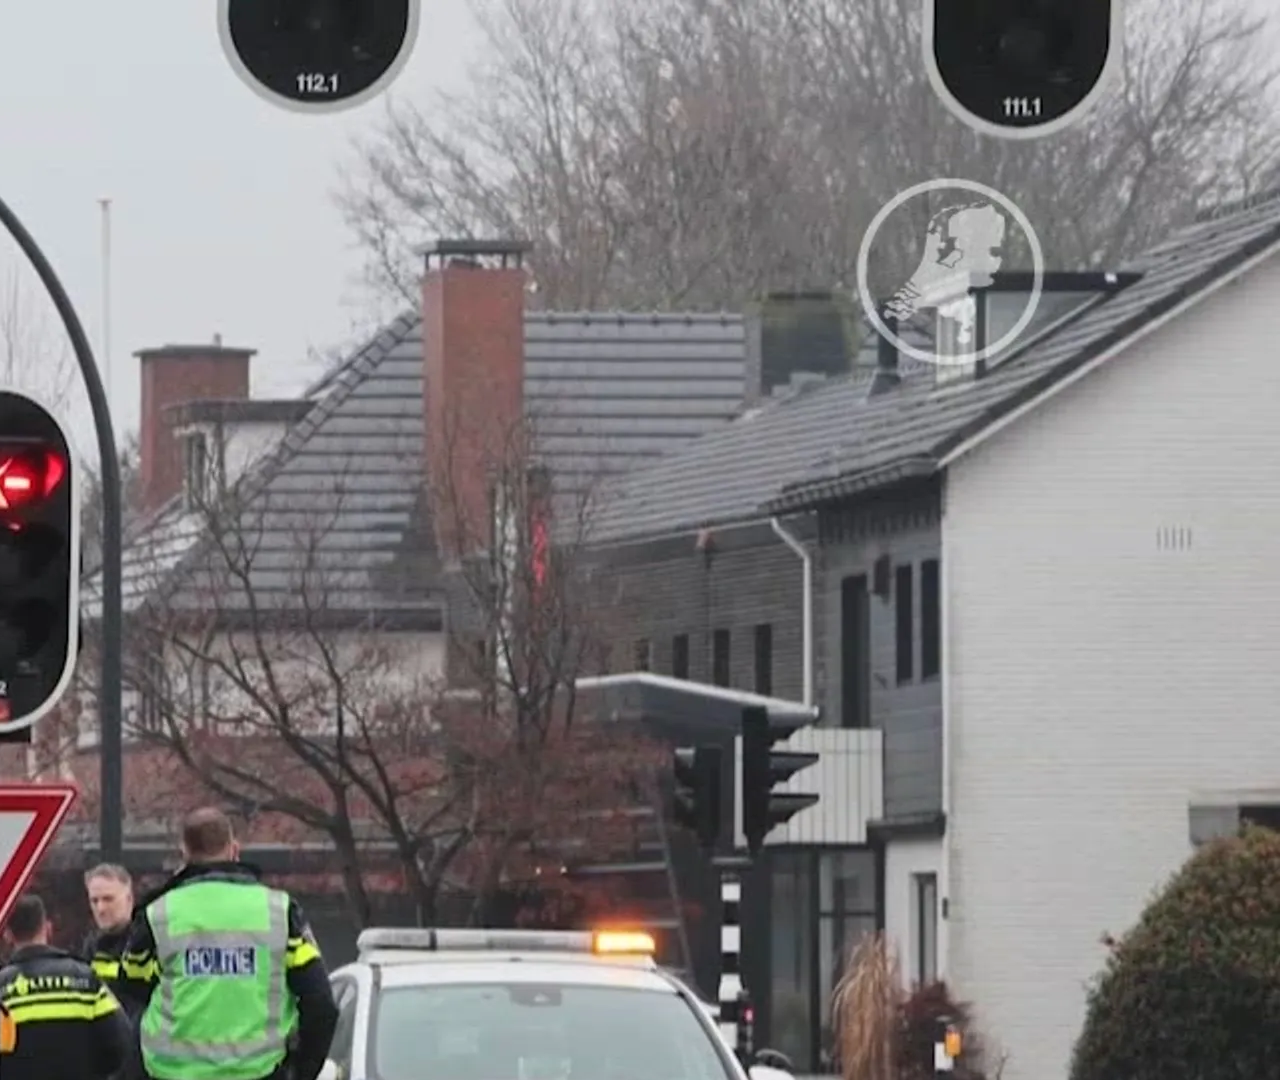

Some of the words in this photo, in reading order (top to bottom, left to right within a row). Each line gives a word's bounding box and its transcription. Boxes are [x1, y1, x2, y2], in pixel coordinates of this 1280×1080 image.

[296, 72, 338, 93] 112.1
[1003, 96, 1041, 117] 111.1
[188, 948, 252, 974] POLITIE
